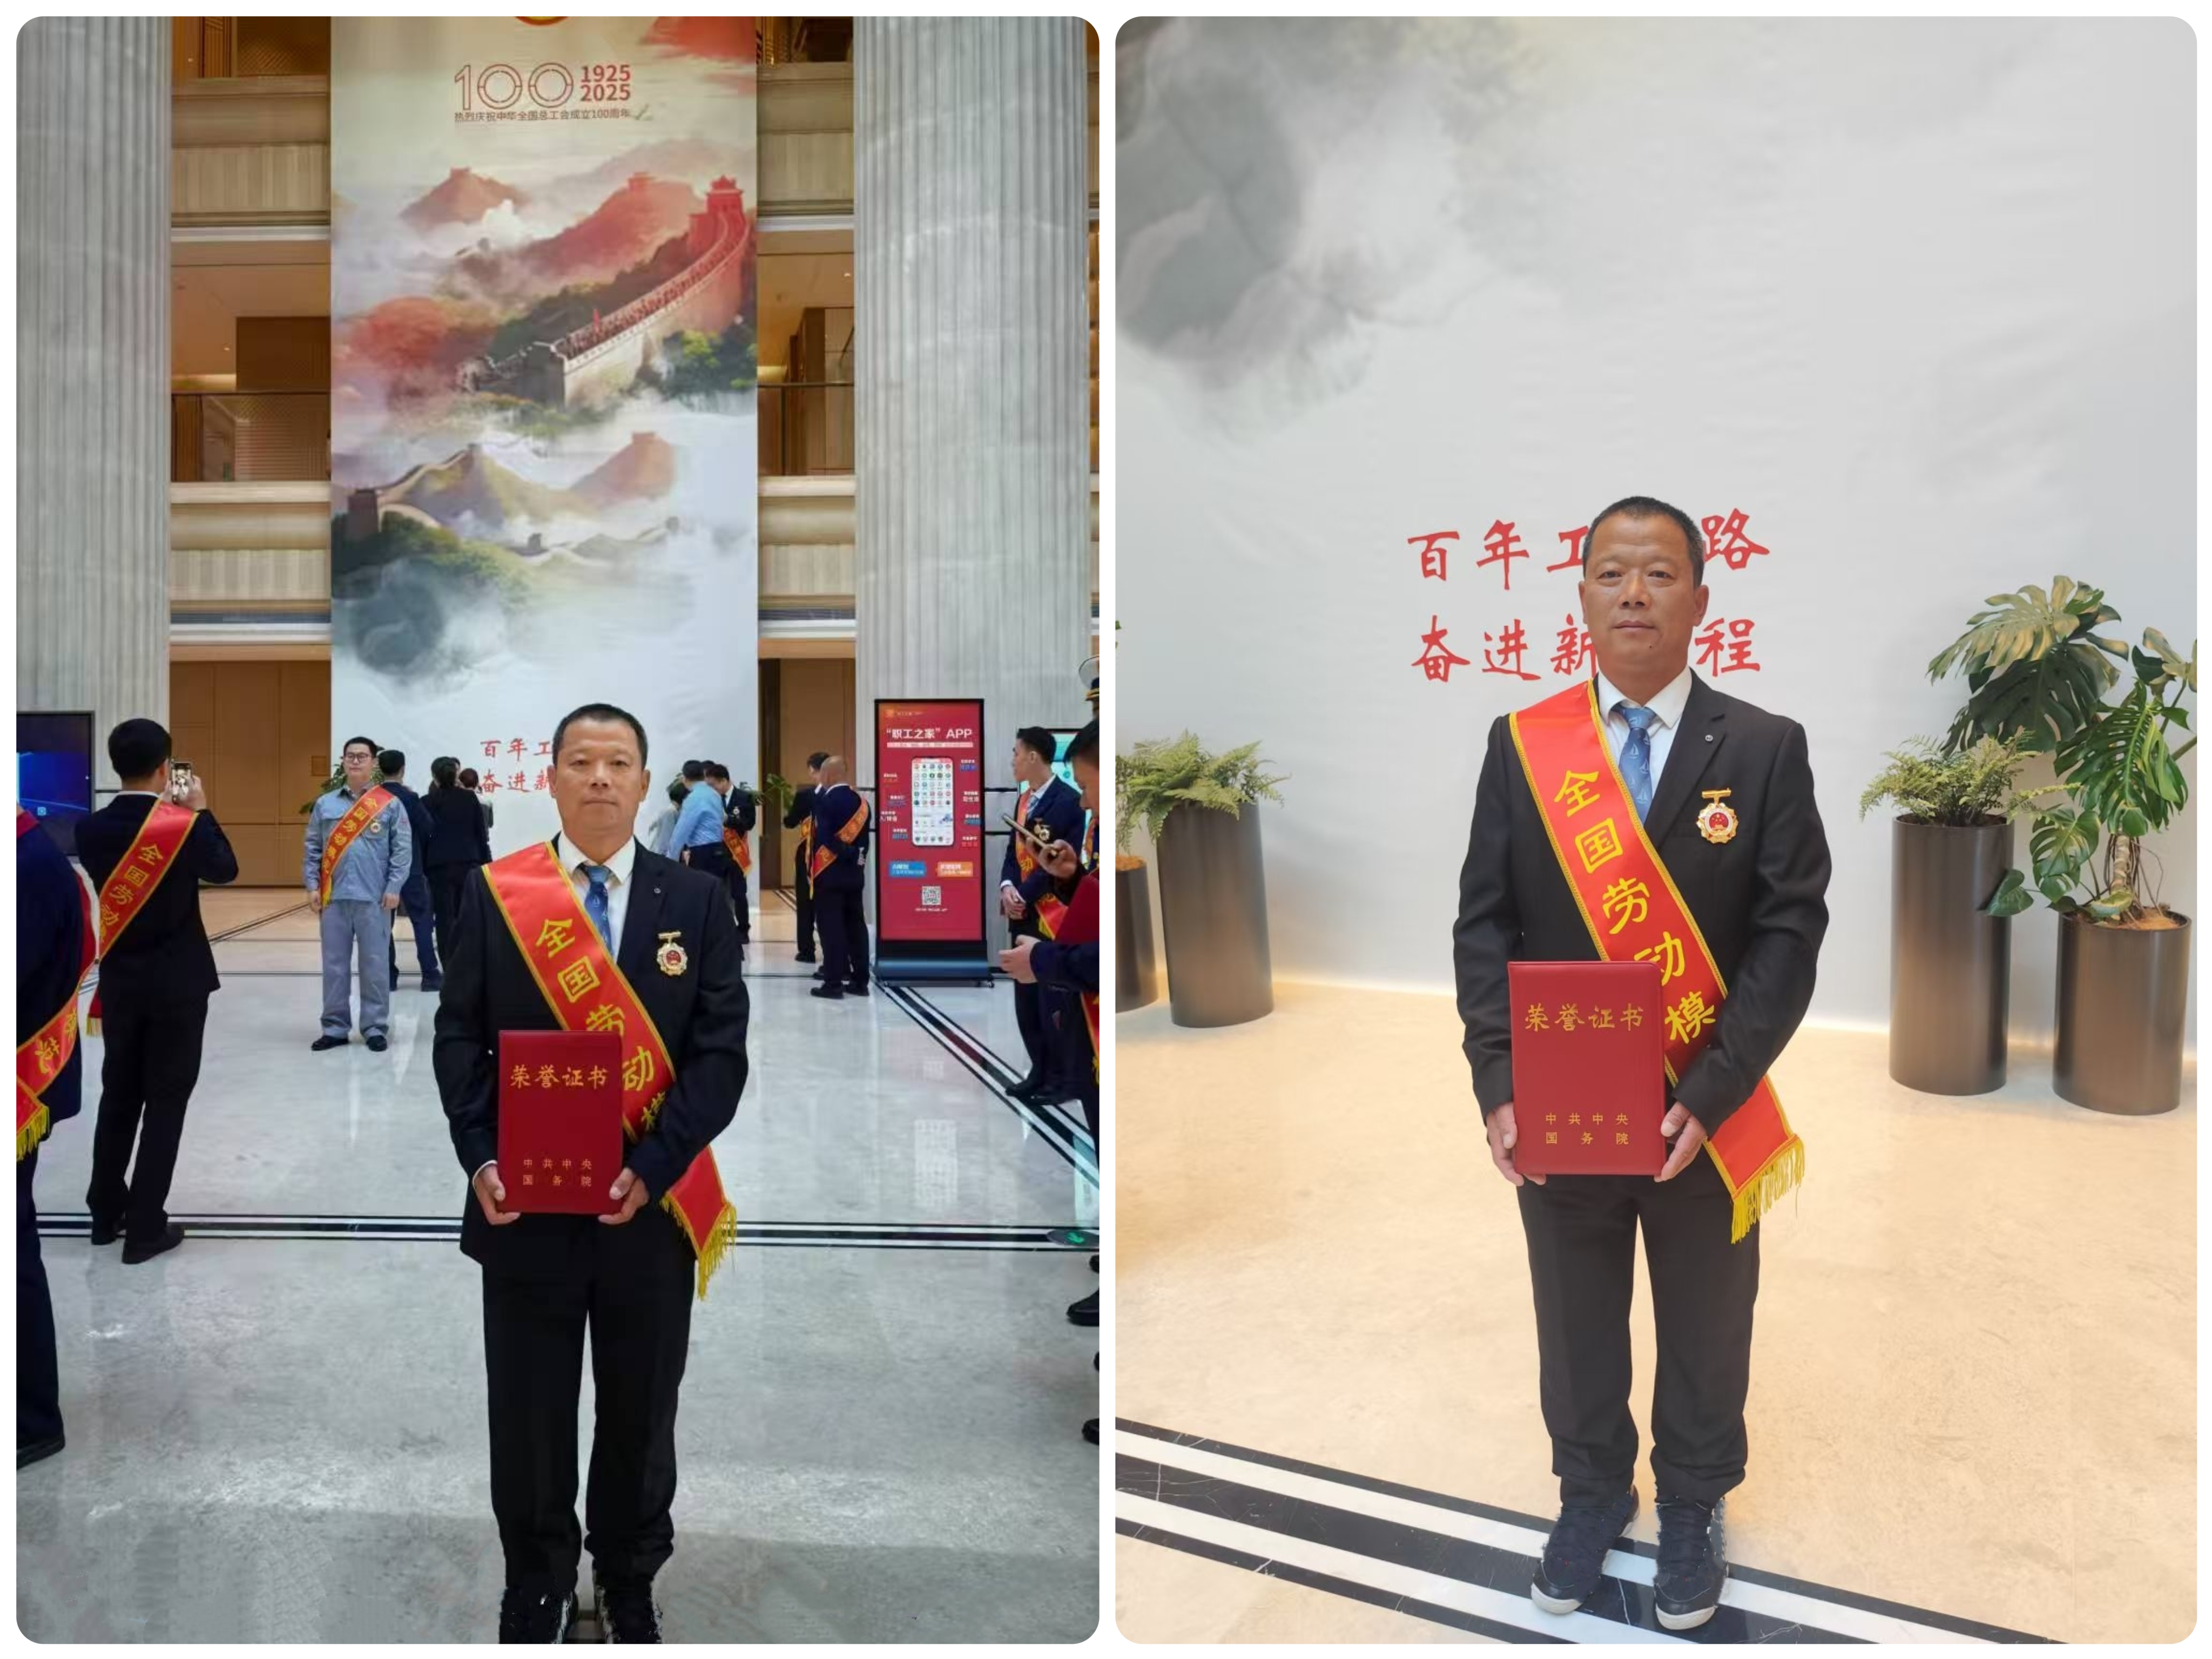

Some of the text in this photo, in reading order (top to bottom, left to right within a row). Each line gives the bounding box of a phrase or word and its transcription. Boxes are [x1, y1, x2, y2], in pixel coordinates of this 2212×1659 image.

[581, 65, 631, 83] 1925
[580, 84, 631, 102] 2025
[454, 109, 630, 122] 热烈庆祝中华全国总工会成立100周年
[1407, 508, 1770, 590] 百年工路
[1412, 613, 1761, 682] 奋进新程
[946, 729, 972, 738] APP
[1554, 770, 1716, 1044] 全国劳动模
[1525, 1003, 1644, 1031] 荣誉证书
[510, 1065, 609, 1089] 荣誉证书
[1546, 1113, 1629, 1126] 中共中央
[1546, 1132, 1629, 1145] 国务院
[523, 1158, 592, 1170] 中共中央
[523, 1174, 592, 1186] 国务院
